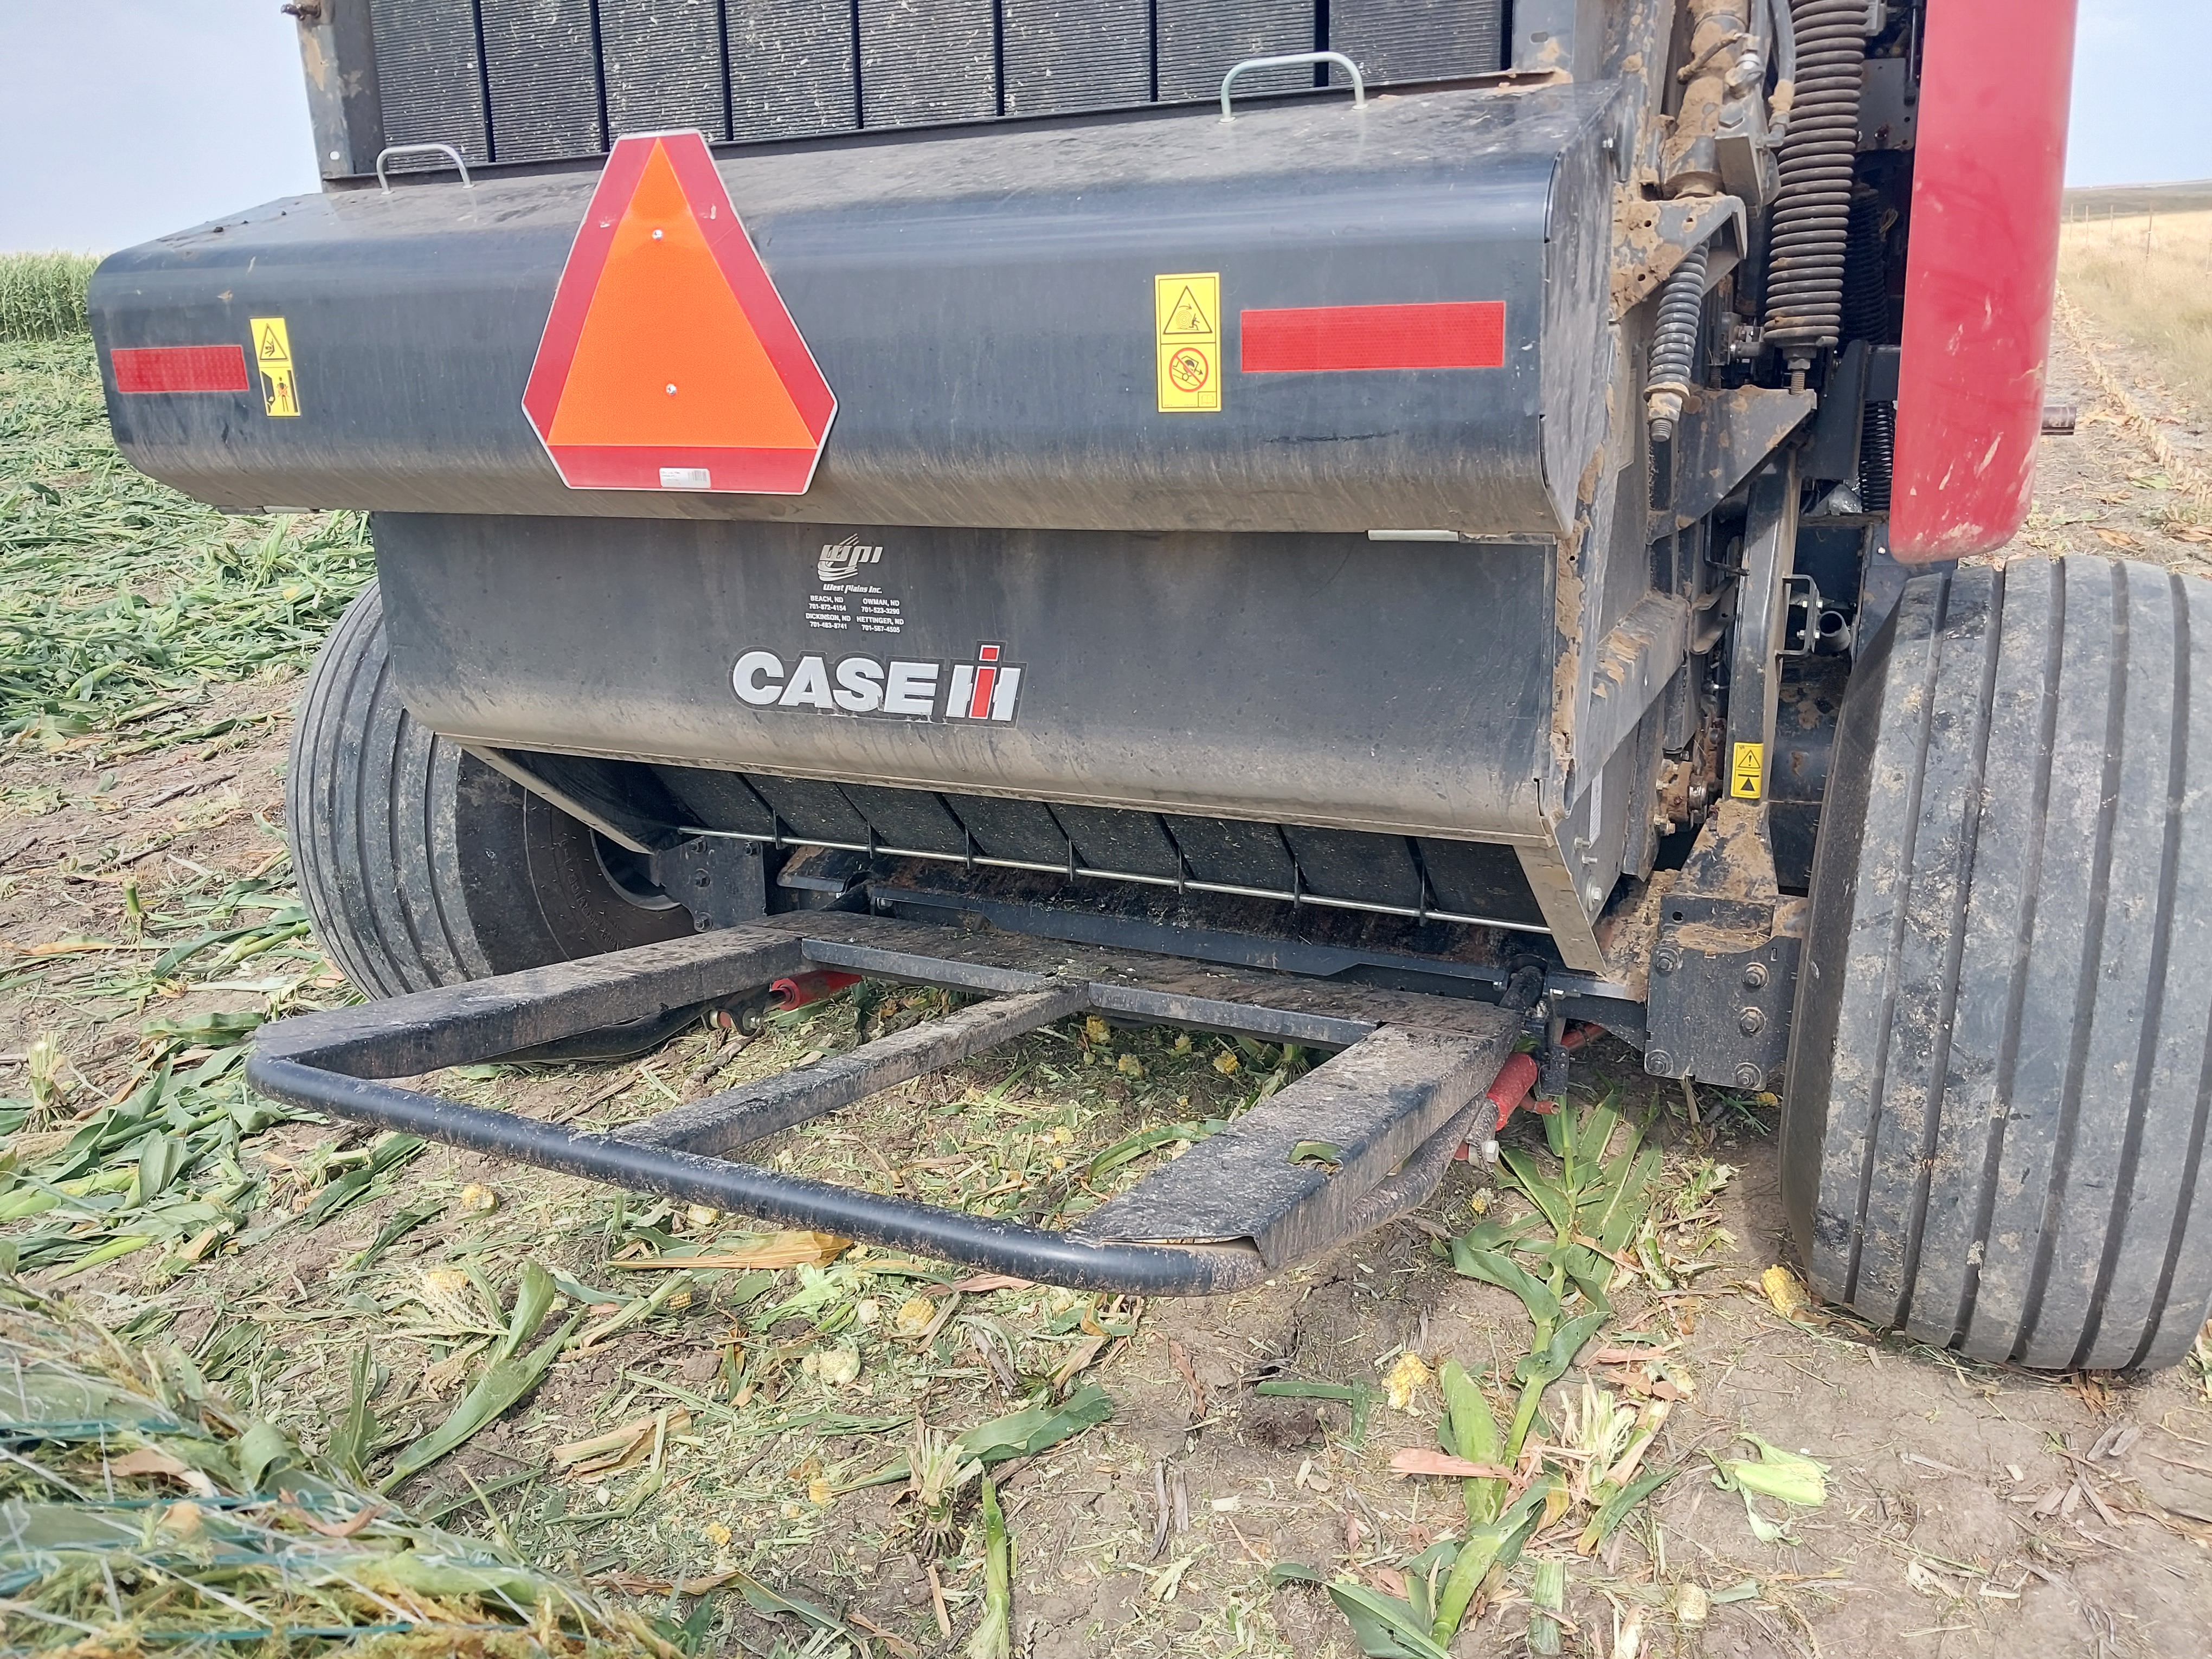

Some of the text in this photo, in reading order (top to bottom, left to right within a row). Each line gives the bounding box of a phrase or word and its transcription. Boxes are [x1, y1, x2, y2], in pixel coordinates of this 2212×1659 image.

[844, 584, 867, 594] Plains
[806, 613, 841, 621] DICKINSON,
[857, 616, 893, 625] HETTINGER,
[732, 644, 1021, 722] CASE IH
